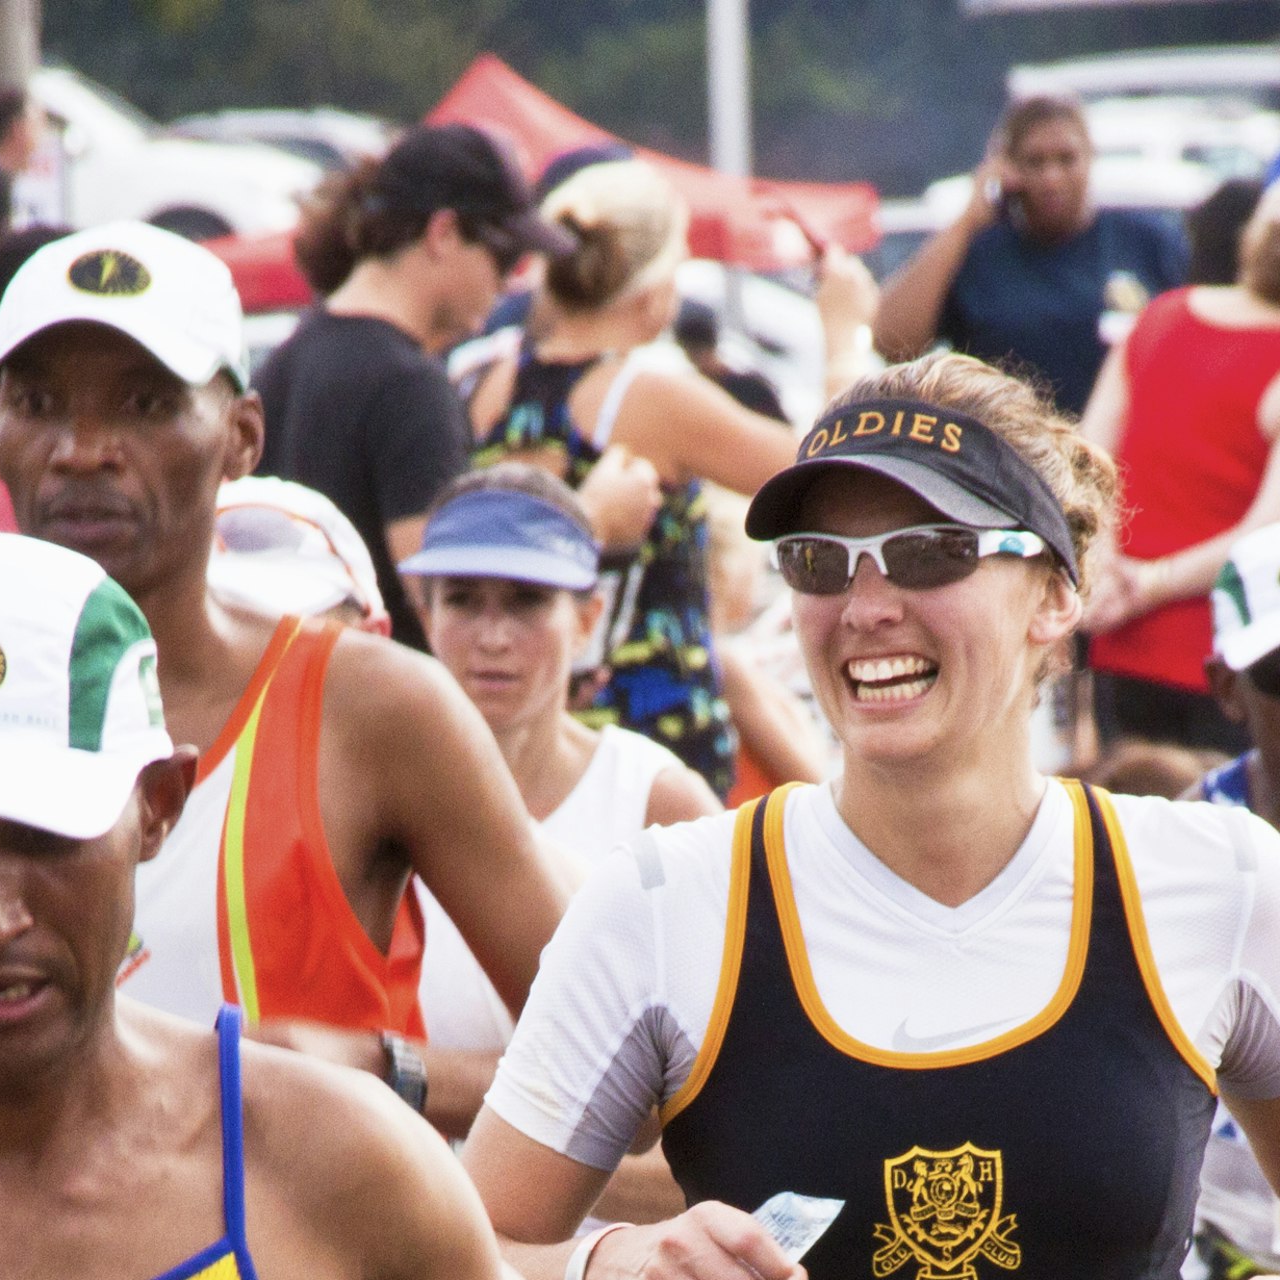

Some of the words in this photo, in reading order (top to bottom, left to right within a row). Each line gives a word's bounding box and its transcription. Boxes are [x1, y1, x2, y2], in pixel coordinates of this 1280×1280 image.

[806, 411, 963, 458] OLDIES
[881, 1247, 907, 1271] OLD
[984, 1241, 1016, 1266] CLUB
